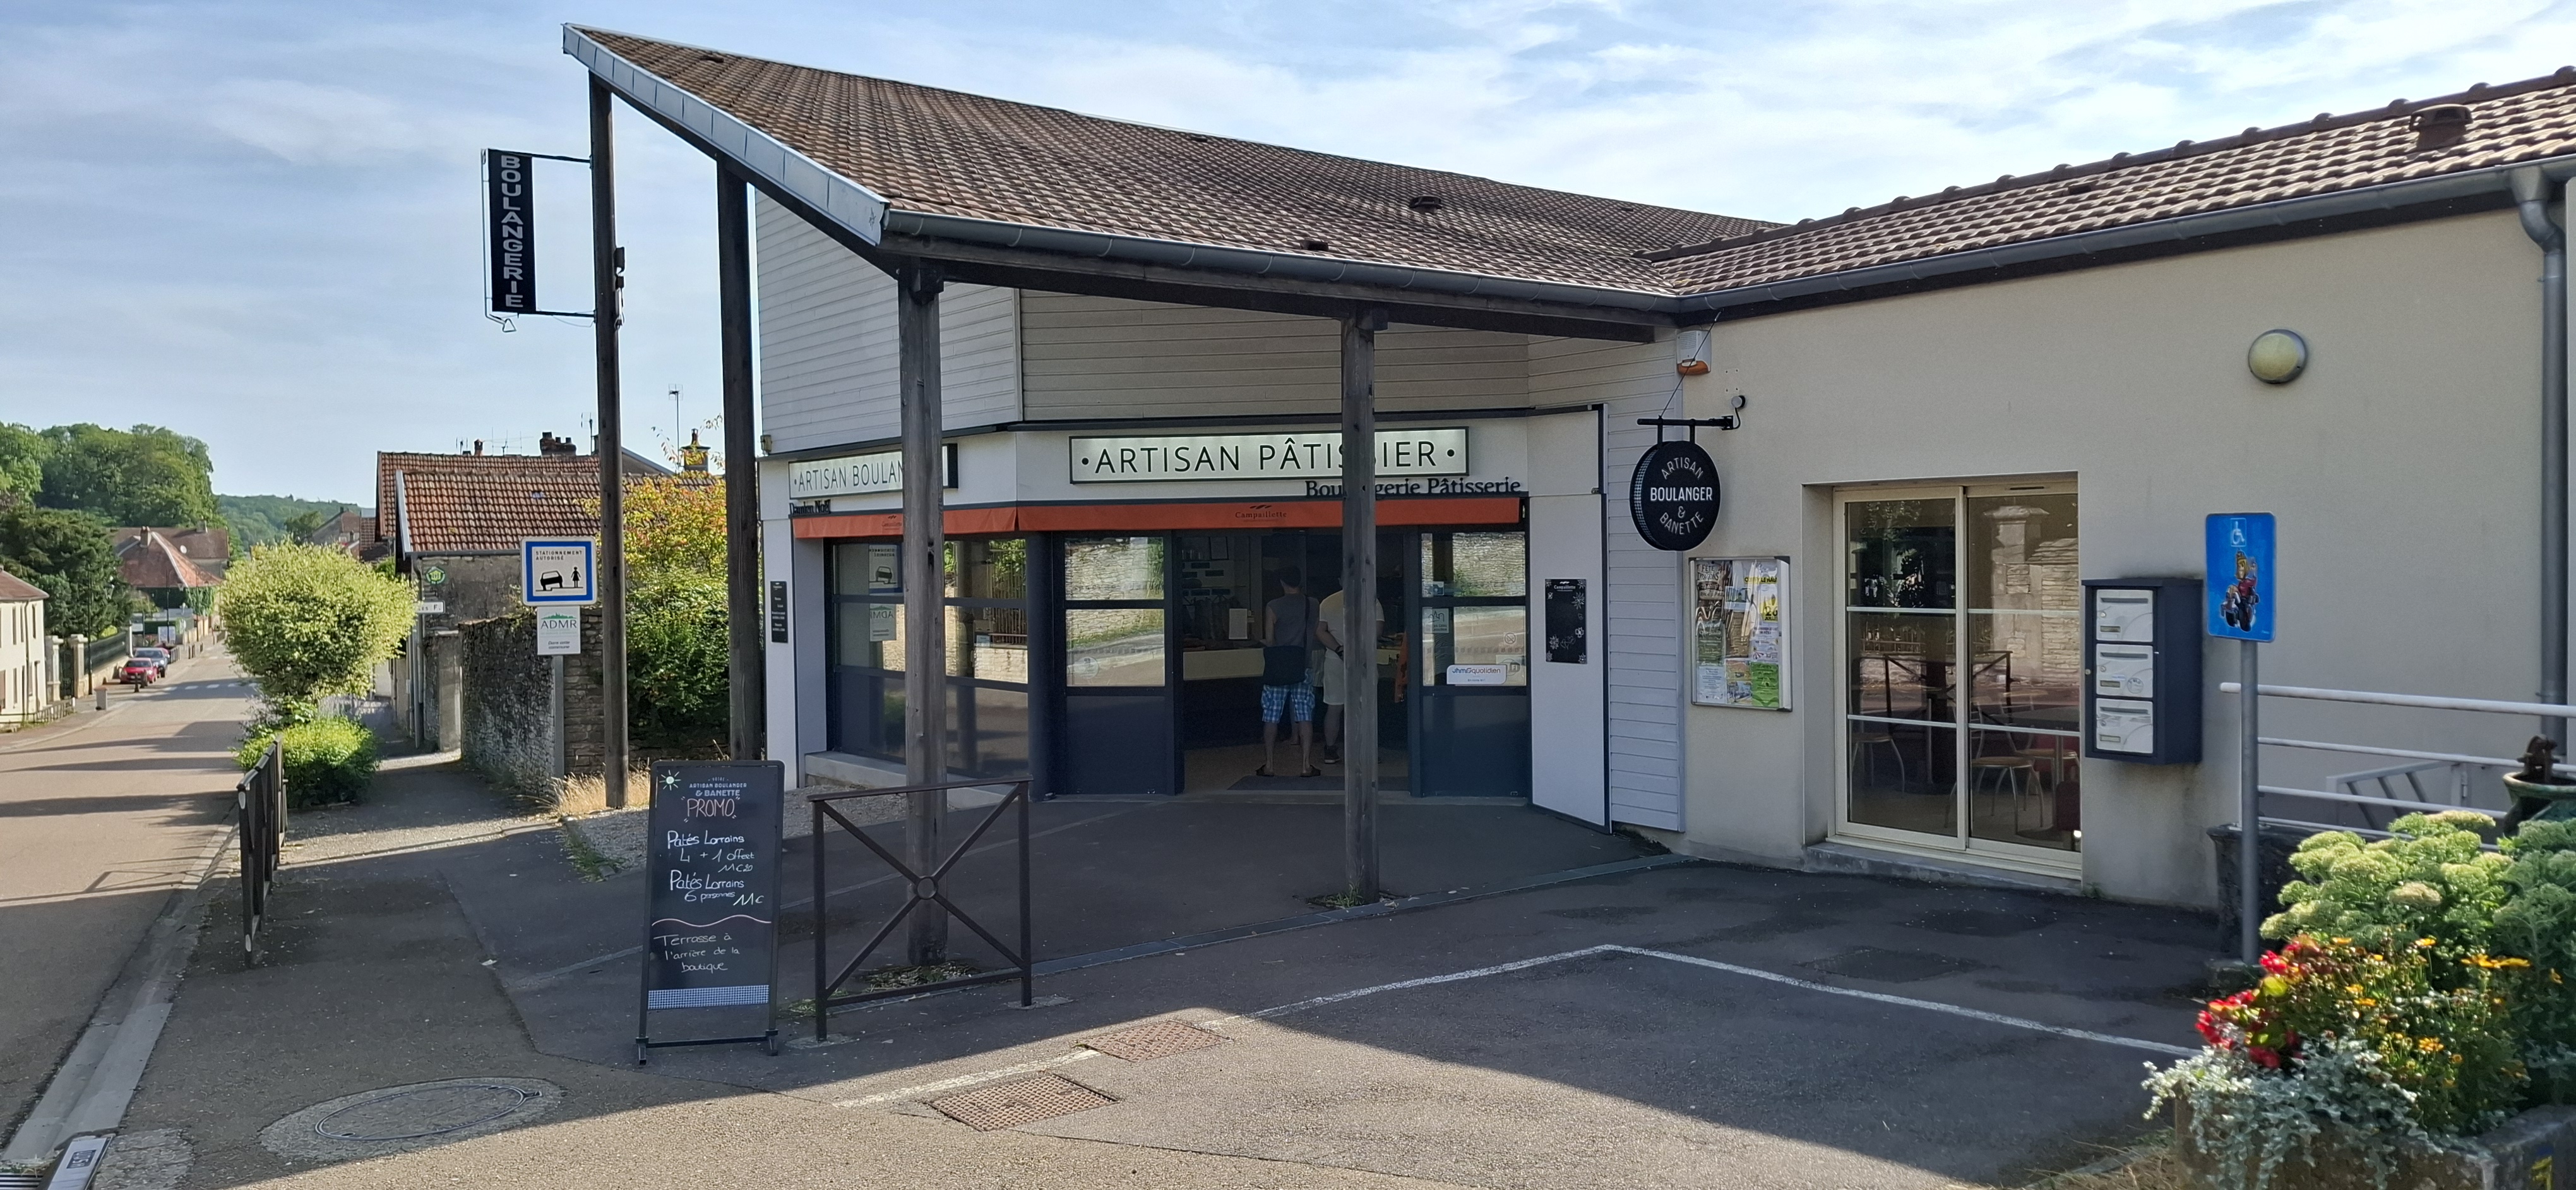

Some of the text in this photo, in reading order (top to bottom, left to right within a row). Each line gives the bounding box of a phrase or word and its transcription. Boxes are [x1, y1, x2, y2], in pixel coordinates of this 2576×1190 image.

[501, 154, 523, 308] BOULANGERIE
[1095, 437, 1436, 474] ARTISAN PÂTIIER
[1661, 456, 1703, 480] ARTISAN
[798, 460, 903, 492] ARTISAN BOULAN
[1306, 476, 1521, 498] Bougerie Pâtisserie
[1650, 486, 1713, 502] BOULANGER
[1235, 510, 1287, 519] Campaillette
[1677, 506, 1686, 519] &
[1659, 510, 1704, 536] BANETTE
[540, 620, 577, 629] ADMR
[704, 829, 745, 844] Lorrains
[680, 848, 691, 863] 4
[711, 848, 722, 863] 1
[705, 873, 745, 889] Lorrains
[684, 890, 697, 903] 6
[653, 932, 732, 947] Terrasse à
[713, 946, 726, 955] de
[731, 946, 741, 955] la
[681, 961, 729, 974] boutique
